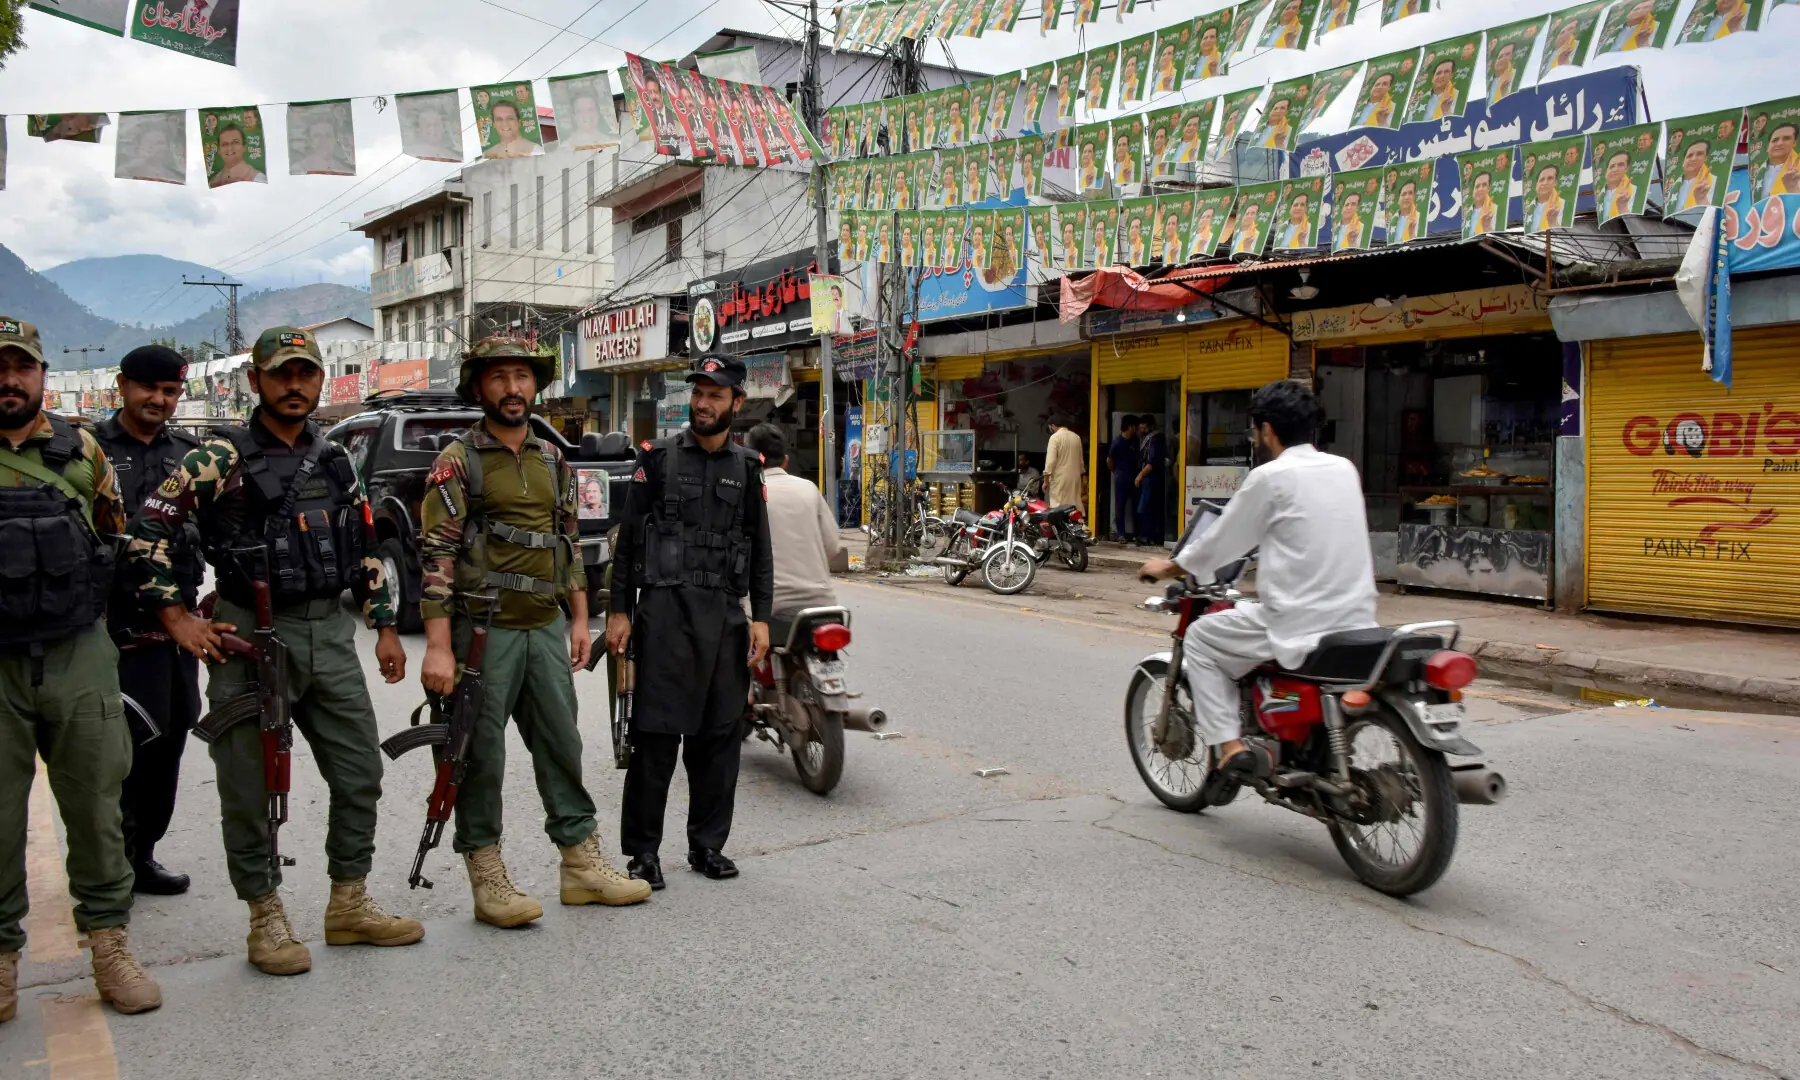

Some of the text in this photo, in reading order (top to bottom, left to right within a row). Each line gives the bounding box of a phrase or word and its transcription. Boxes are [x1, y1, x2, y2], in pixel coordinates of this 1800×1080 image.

[161, 39, 183, 50] LA-29
[1530, 88, 1602, 143] رائل
[1605, 96, 1625, 123] نیو
[616, 303, 656, 331] ULLAH
[594, 335, 640, 361] BAKERS
[1235, 335, 1254, 350] FIX
[1622, 402, 1800, 458] GOBI'S
[1763, 458, 1800, 473] Paint
[722, 478, 735, 486] PAK
[1652, 469, 1692, 496] Think
[1725, 479, 1756, 504] way
[145, 498, 177, 516] PAK FC
[1716, 540, 1751, 560] FIX
